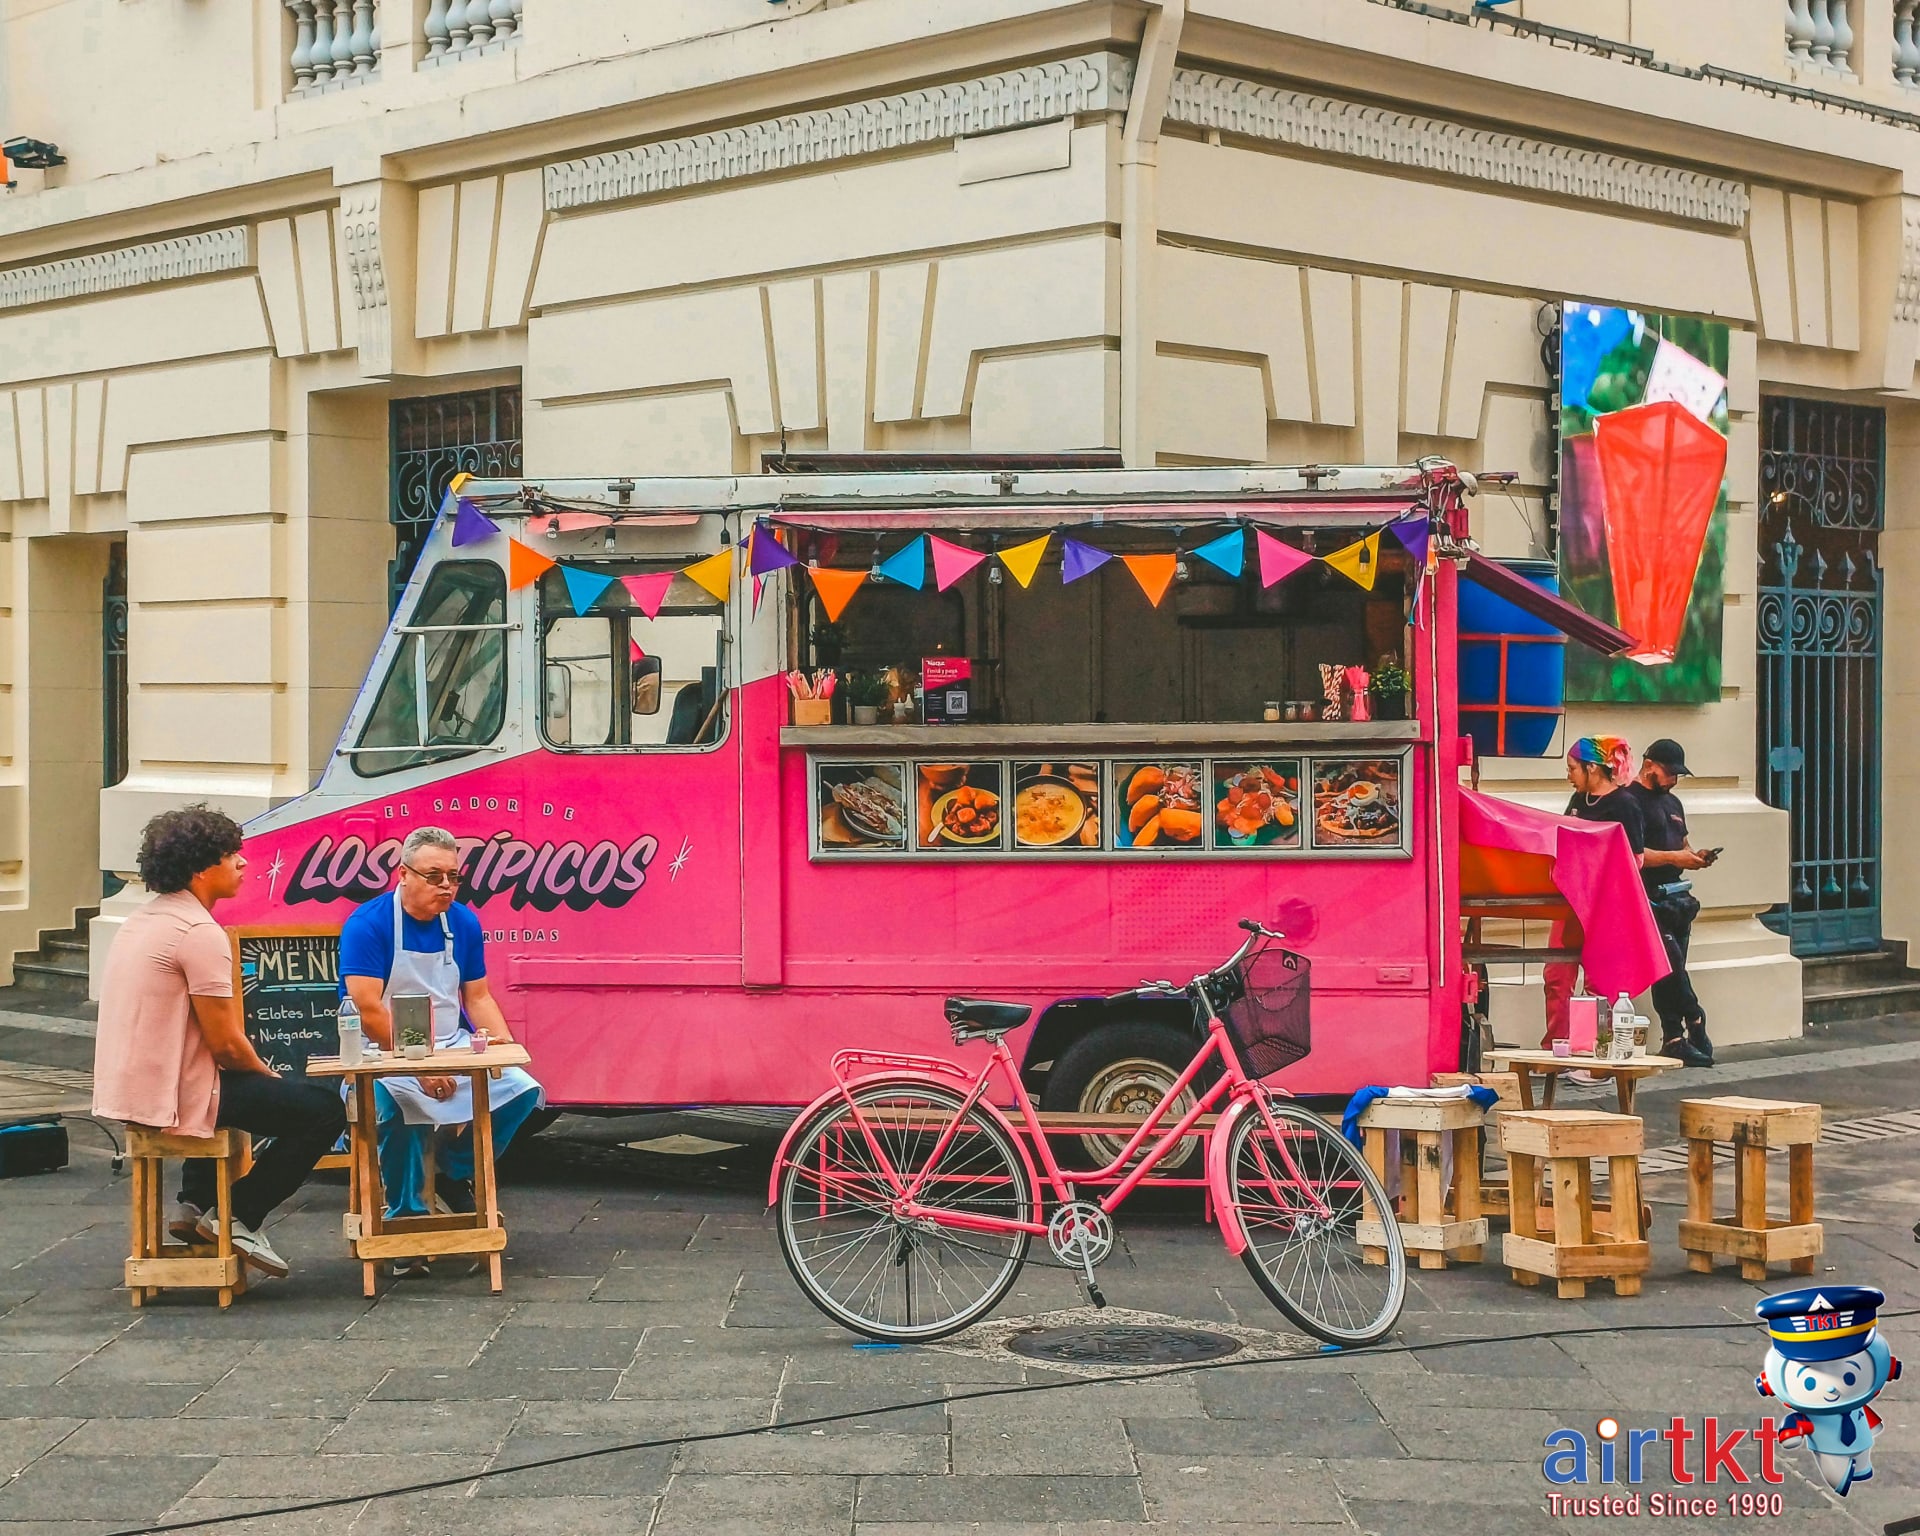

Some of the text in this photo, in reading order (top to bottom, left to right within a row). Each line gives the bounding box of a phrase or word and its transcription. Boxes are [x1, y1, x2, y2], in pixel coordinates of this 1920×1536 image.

[384, 797, 575, 821] EL SABOR DE
[289, 834, 402, 900] LOS
[483, 928, 560, 944] RUEDAS
[256, 1001, 338, 1021] Elotes Loc
[262, 1055, 294, 1072] Yuca
